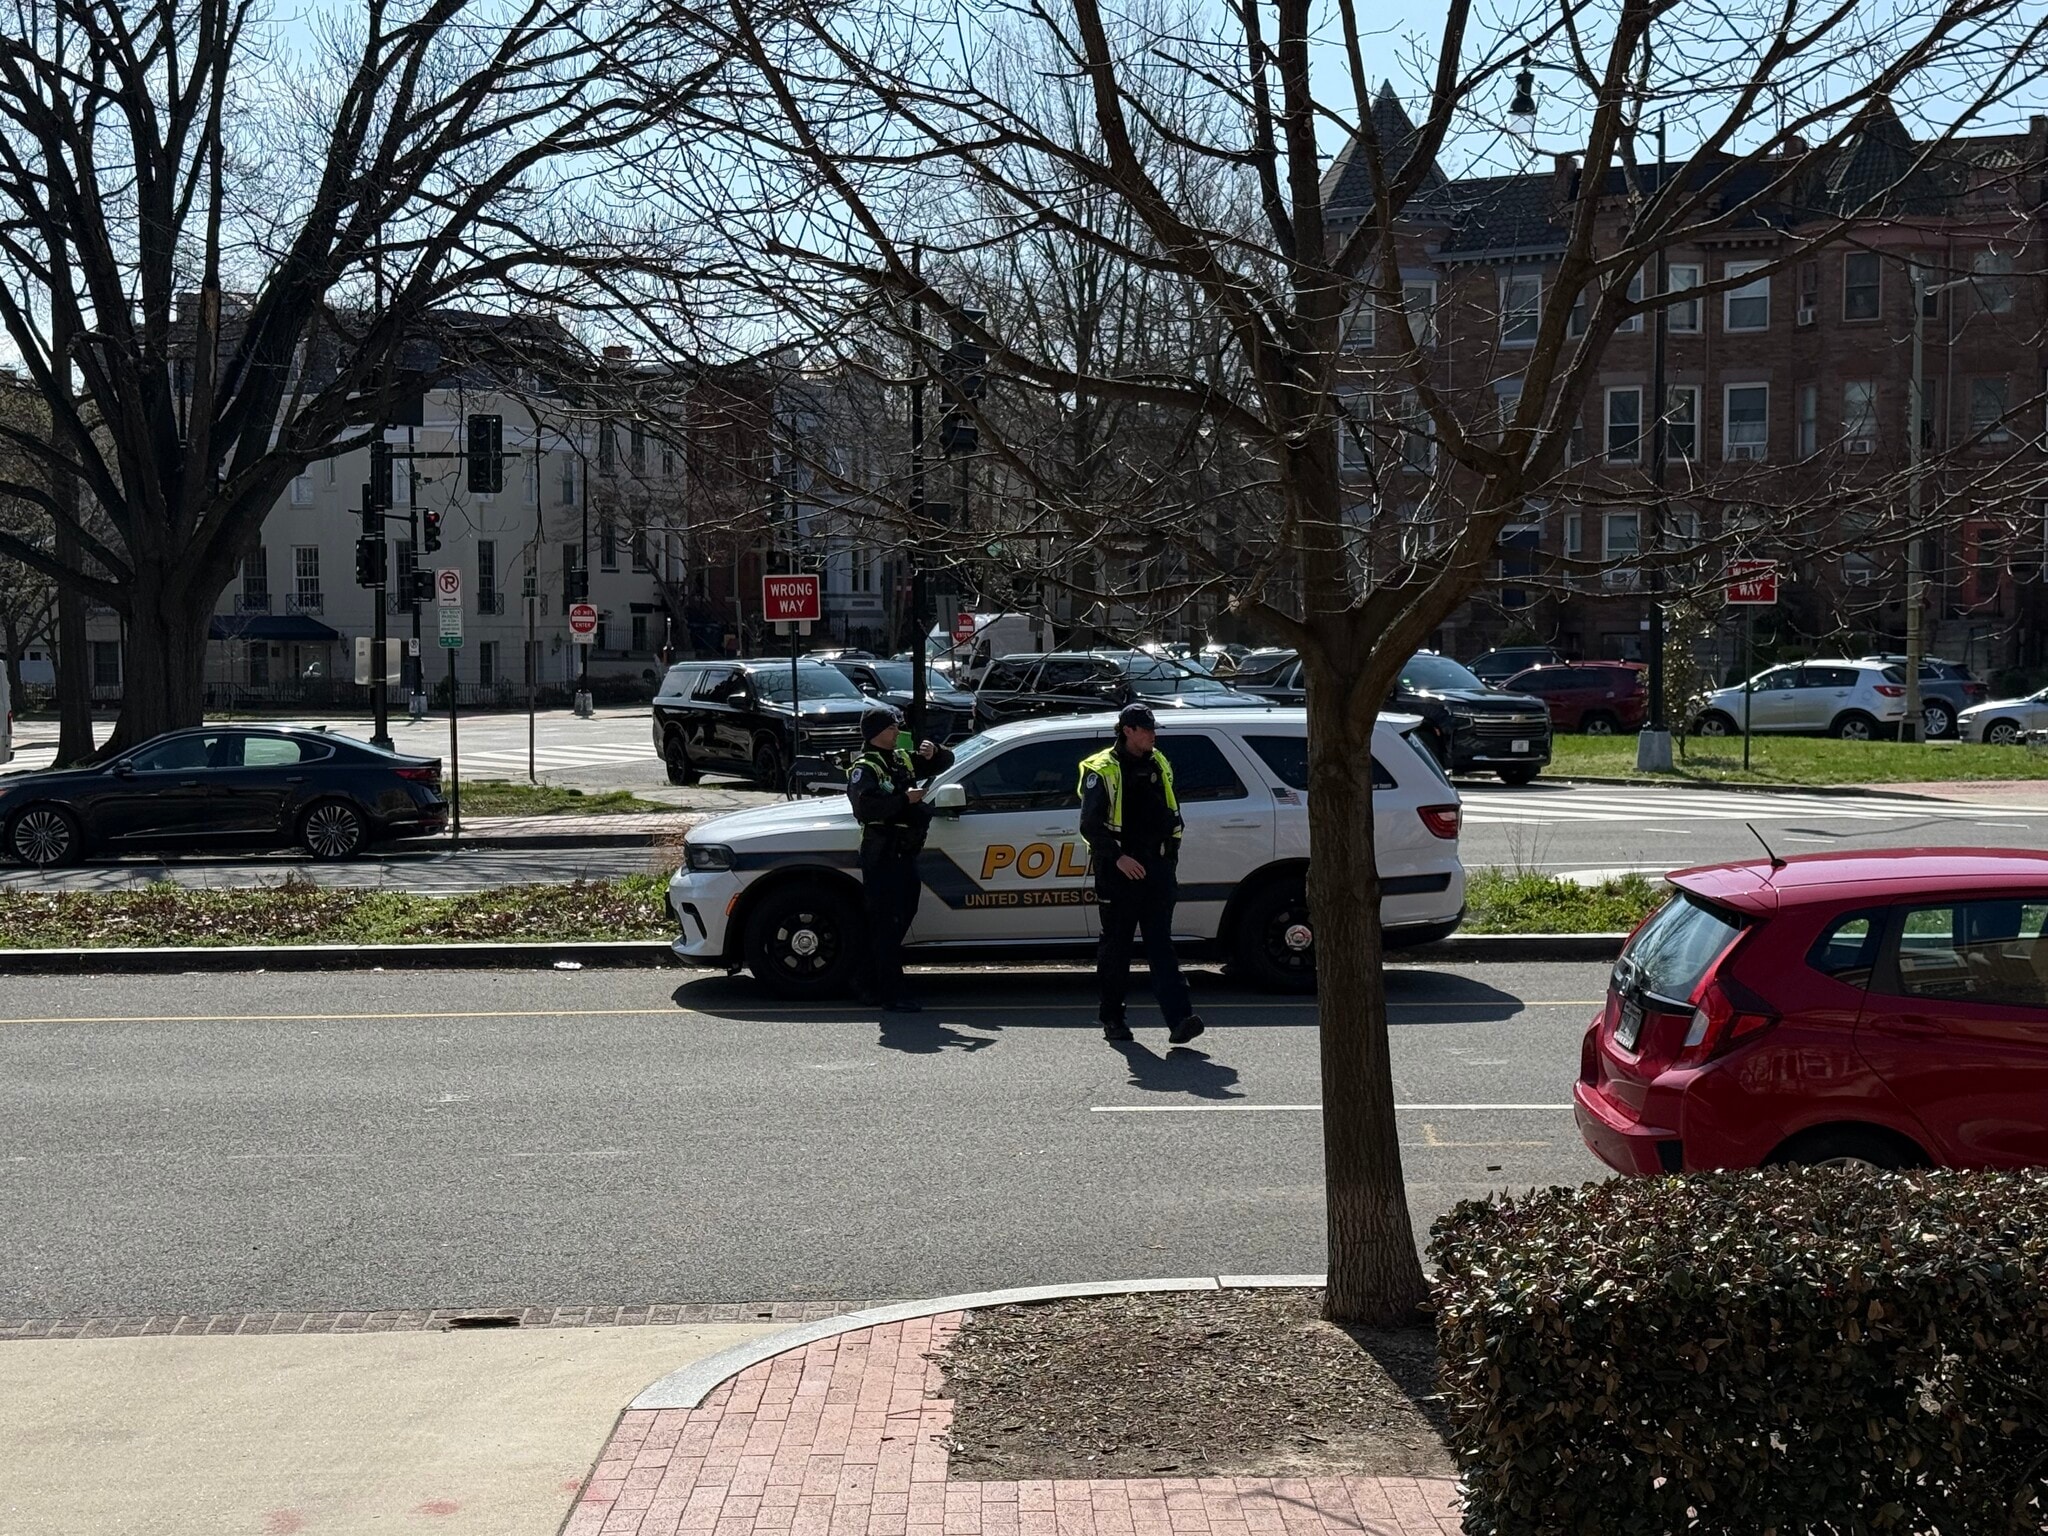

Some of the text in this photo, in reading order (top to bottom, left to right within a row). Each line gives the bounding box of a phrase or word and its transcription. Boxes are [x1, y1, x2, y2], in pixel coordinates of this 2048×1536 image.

[770, 583, 813, 597] WRONG
[1738, 583, 1763, 596] WAY
[779, 600, 805, 613] WAY
[980, 842, 1096, 880] POL
[964, 893, 1019, 906] UNITED
[1023, 891, 1080, 905] STATES
